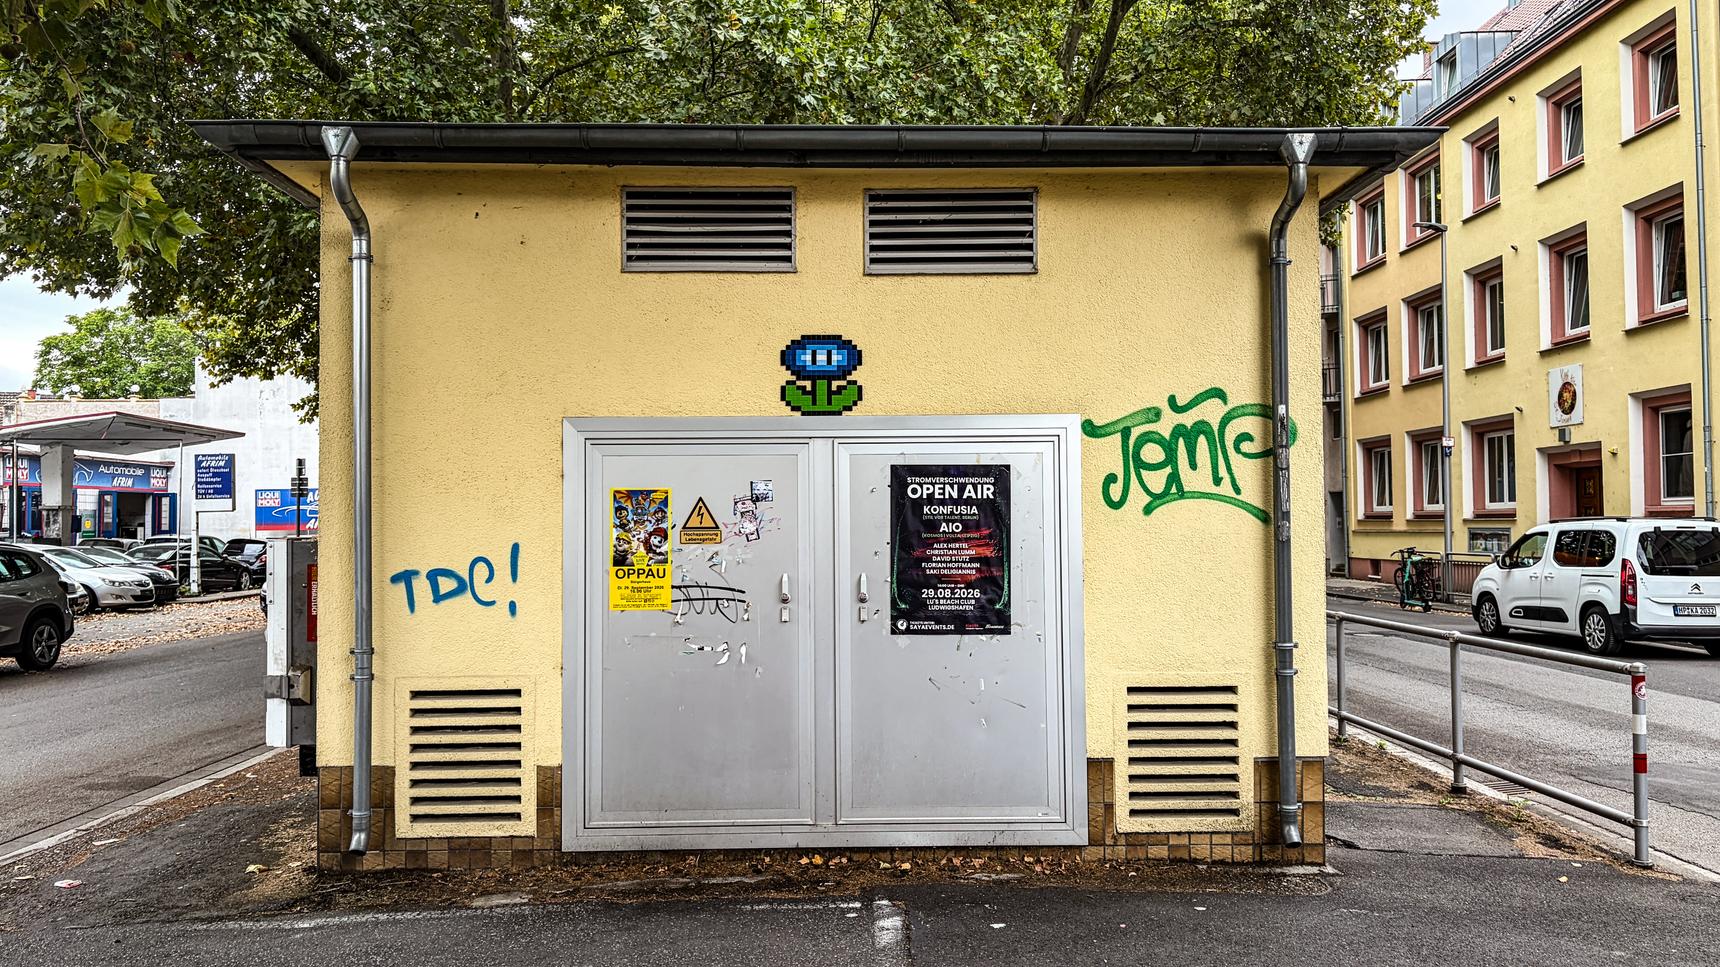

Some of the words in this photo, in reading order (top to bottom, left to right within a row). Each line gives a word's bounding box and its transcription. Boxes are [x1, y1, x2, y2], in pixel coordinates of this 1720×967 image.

[6, 469, 28, 480] MLY
[98, 465, 145, 475] Automobile
[151, 468, 167, 477] LIQUI
[112, 477, 133, 487] AFRIM
[150, 478, 167, 487] MOLY
[907, 484, 958, 499] OPEN
[962, 484, 994, 499] AIR
[924, 506, 978, 514] KONFUSIA
[940, 522, 962, 532] AIO
[615, 568, 666, 579] OPPAU
[922, 589, 981, 598] 29.08.2026
